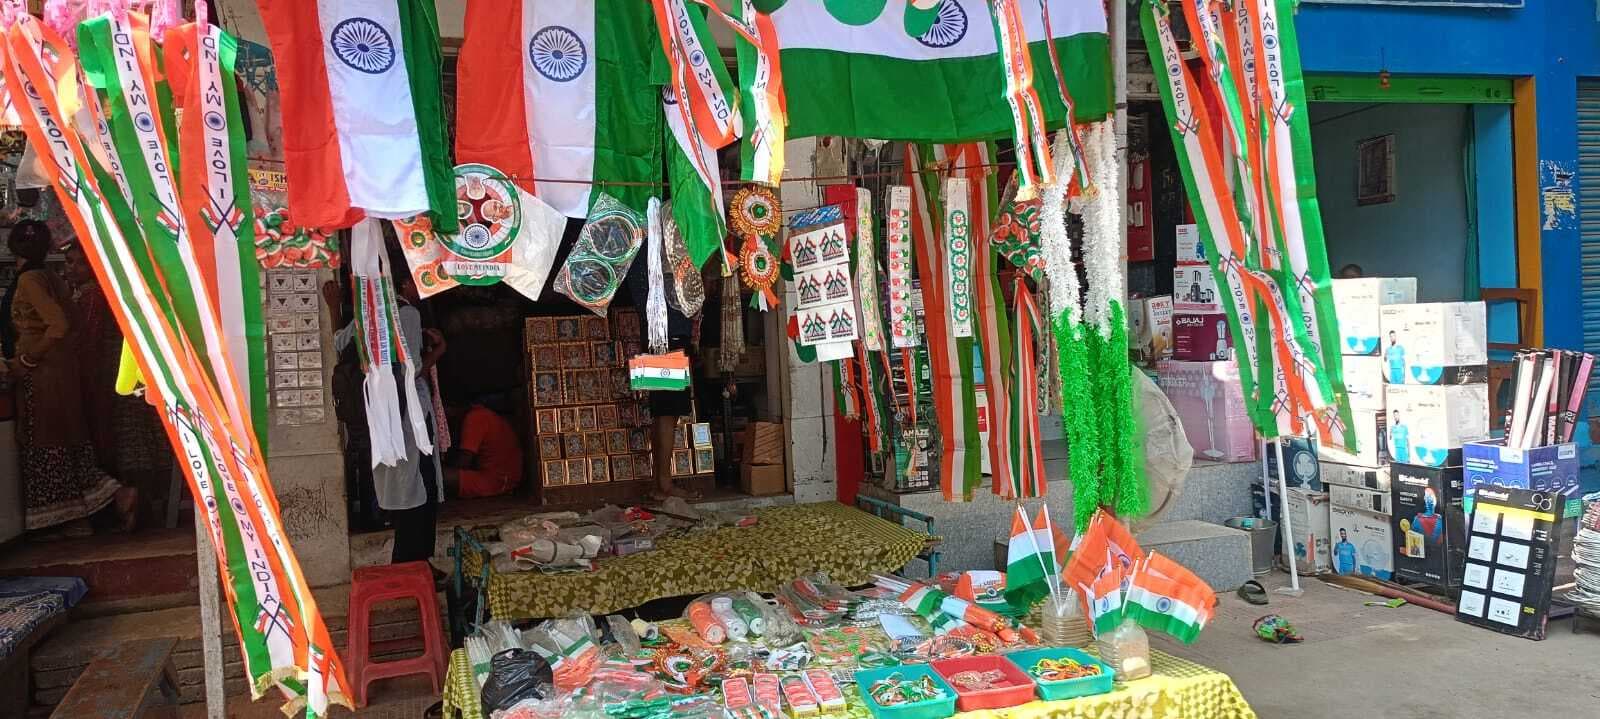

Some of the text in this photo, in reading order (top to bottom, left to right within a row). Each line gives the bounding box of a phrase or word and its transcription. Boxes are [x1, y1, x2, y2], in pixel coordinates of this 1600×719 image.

[1263, 13, 1275, 31] MY
[1267, 54, 1280, 87] LOVE
[130, 80, 148, 107] MY
[205, 81, 222, 107] MY
[38, 106, 69, 151] LOVE
[146, 139, 170, 187] LOVE
[211, 137, 228, 183] LOVE
[1181, 315, 1204, 325] BAJAJ
[1233, 283, 1246, 311] LOVE
[1244, 327, 1255, 342] MY
[188, 448, 208, 490] LOVE
[213, 452, 237, 492] LOVE
[240, 519, 255, 542] MY
[251, 548, 279, 605] INDIA
